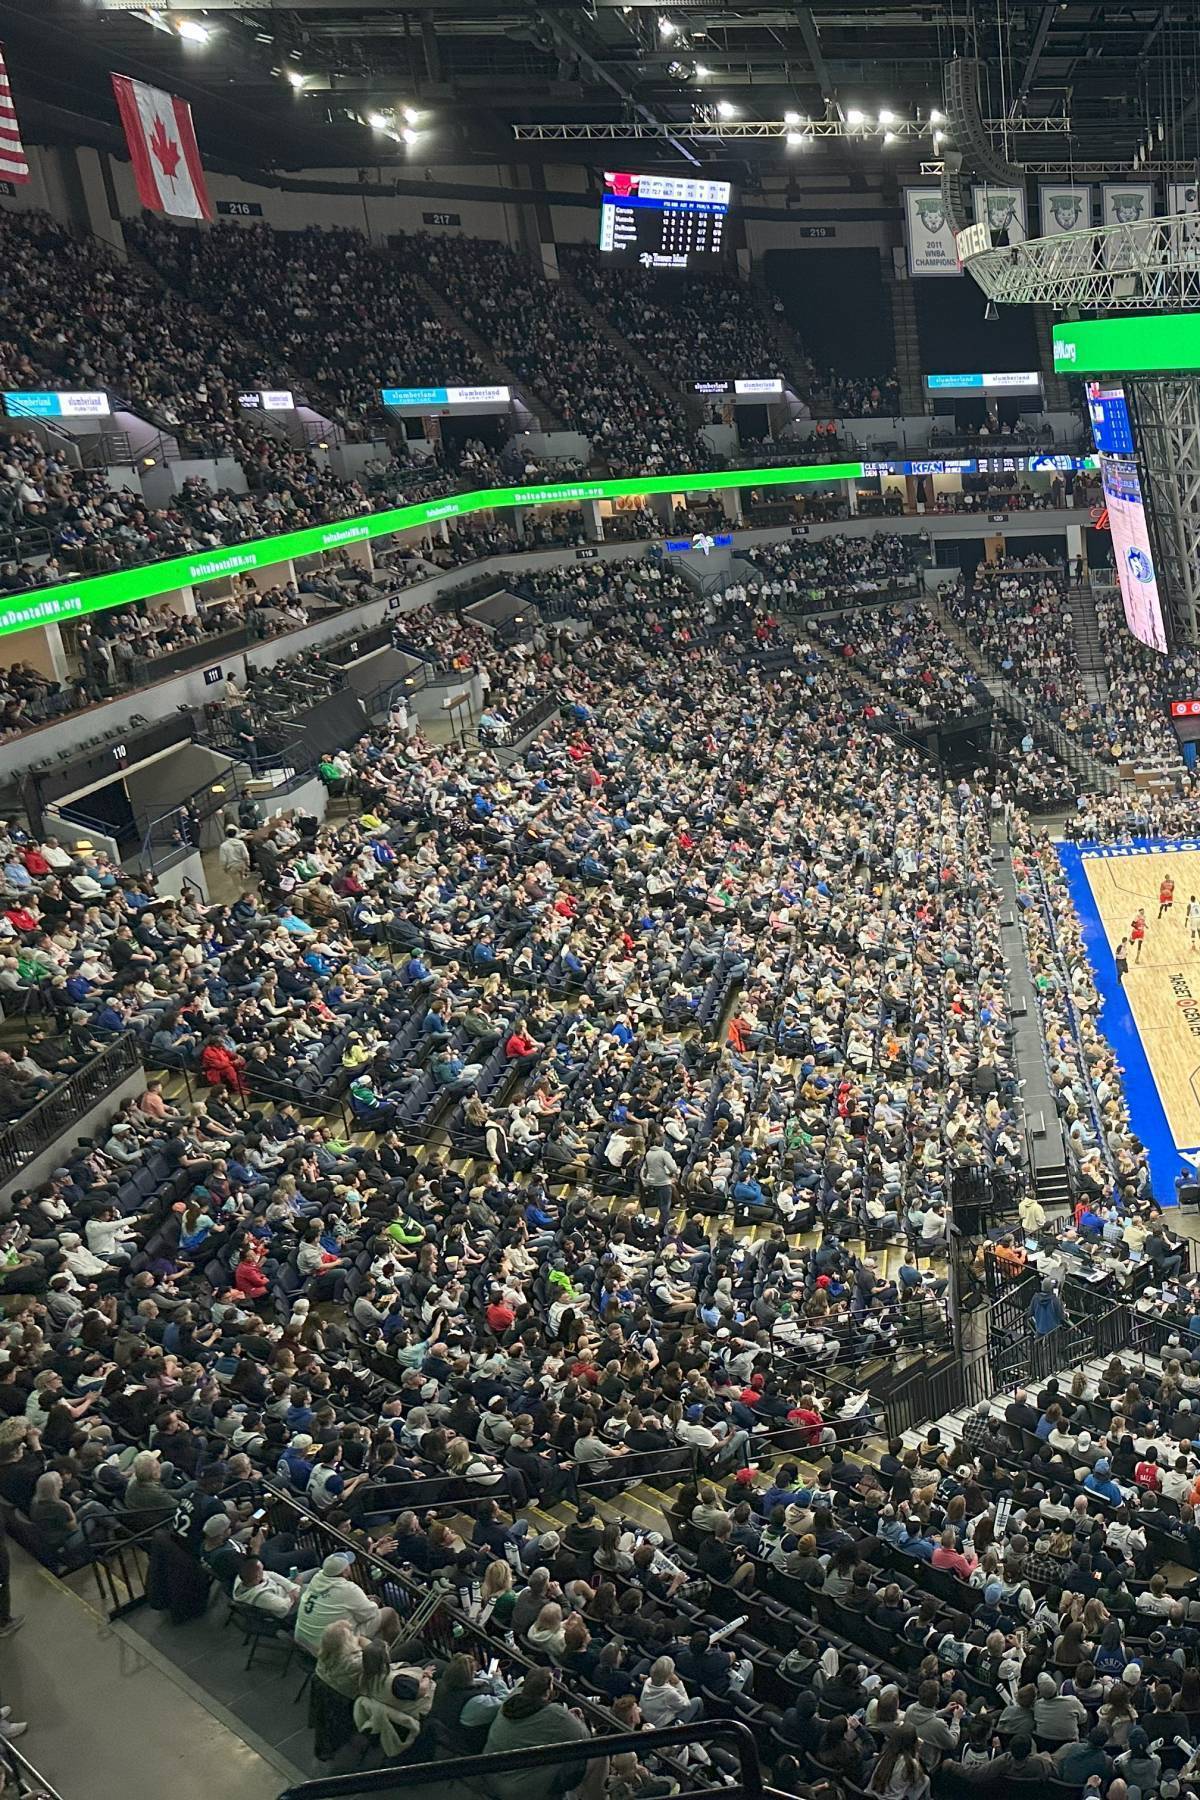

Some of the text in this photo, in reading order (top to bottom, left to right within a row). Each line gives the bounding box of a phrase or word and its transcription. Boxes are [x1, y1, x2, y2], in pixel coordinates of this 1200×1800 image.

[229, 203, 250, 215] 216
[433, 213, 450, 225] 217
[809, 228, 826, 237] 219
[926, 241, 943, 249] 2011
[925, 249, 946, 258] WNBA
[915, 257, 957, 266] CHAMPIONS
[912, 461, 944, 474] KFAN
[112, 744, 127, 760] 110
[1168, 972, 1193, 999] TARGET
[304, 1594, 318, 1615] 5
